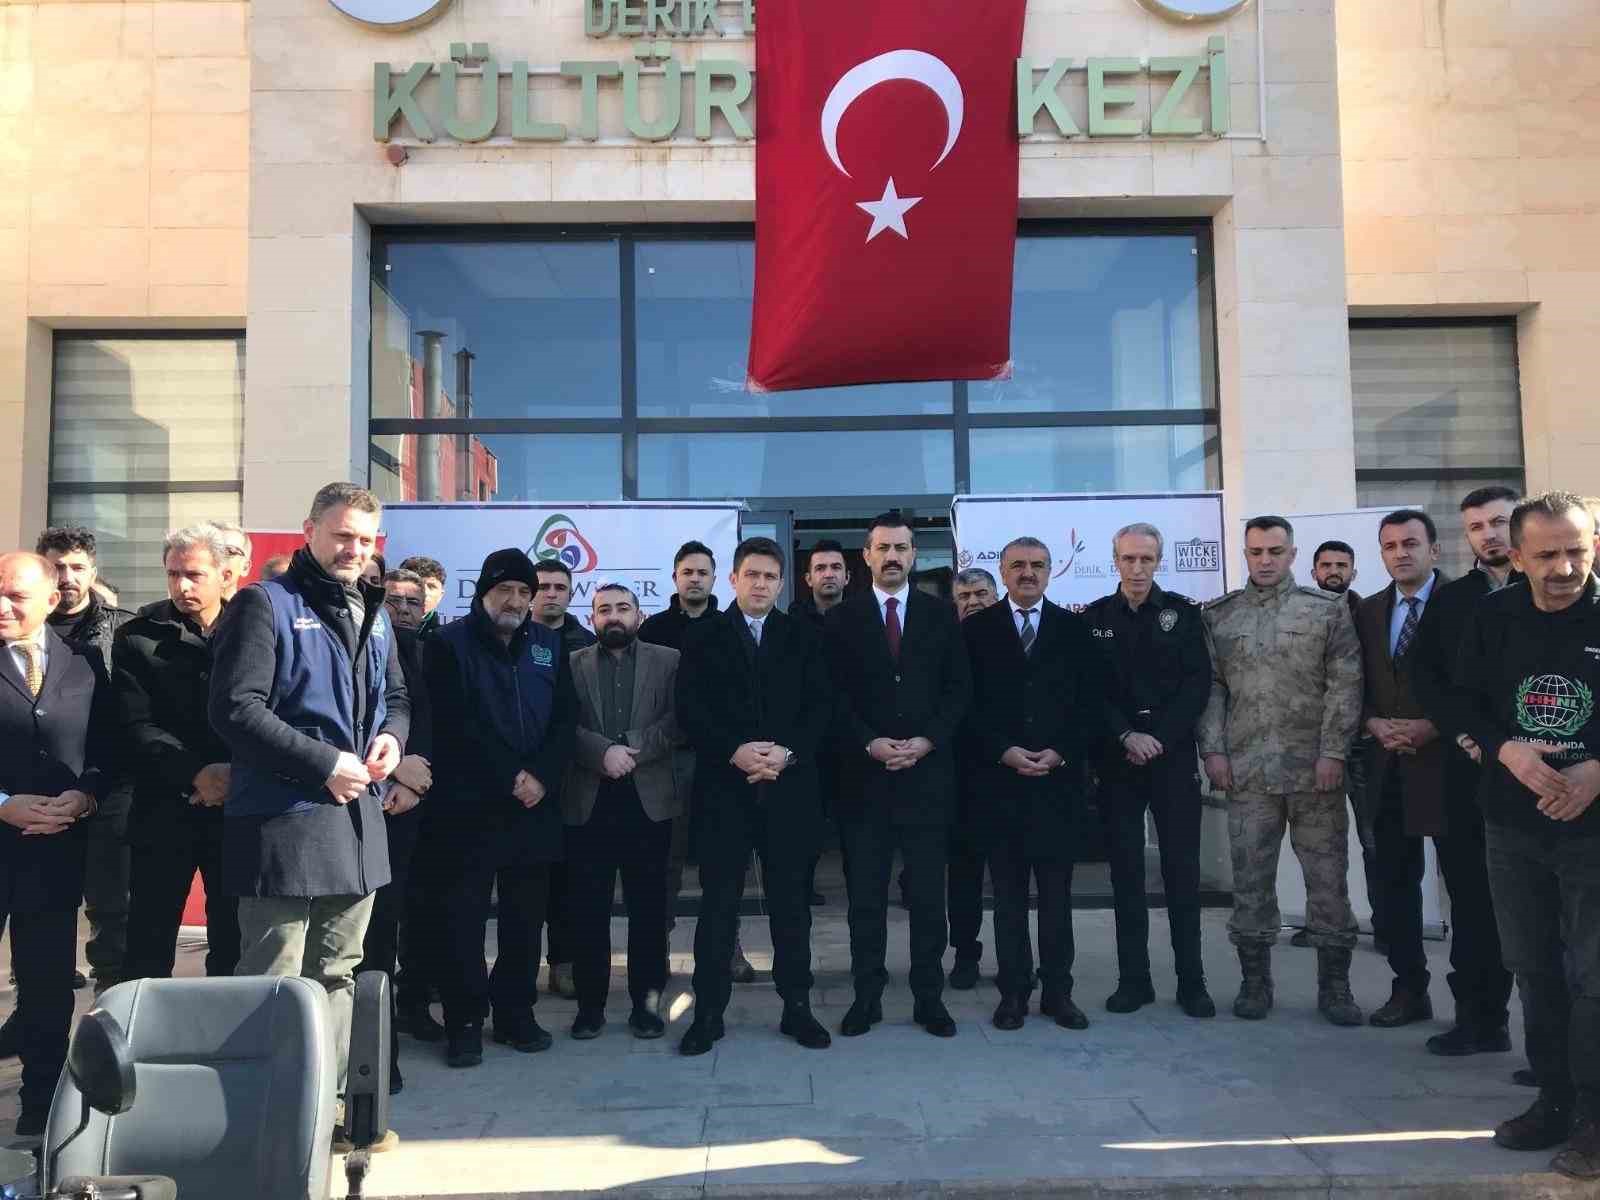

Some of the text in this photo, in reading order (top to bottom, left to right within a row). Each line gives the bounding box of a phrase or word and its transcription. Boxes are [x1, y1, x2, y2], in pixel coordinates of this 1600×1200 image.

[374, 36, 1228, 142] KÜLTÜR KEZİ
[1178, 545, 1217, 557] WICKE
